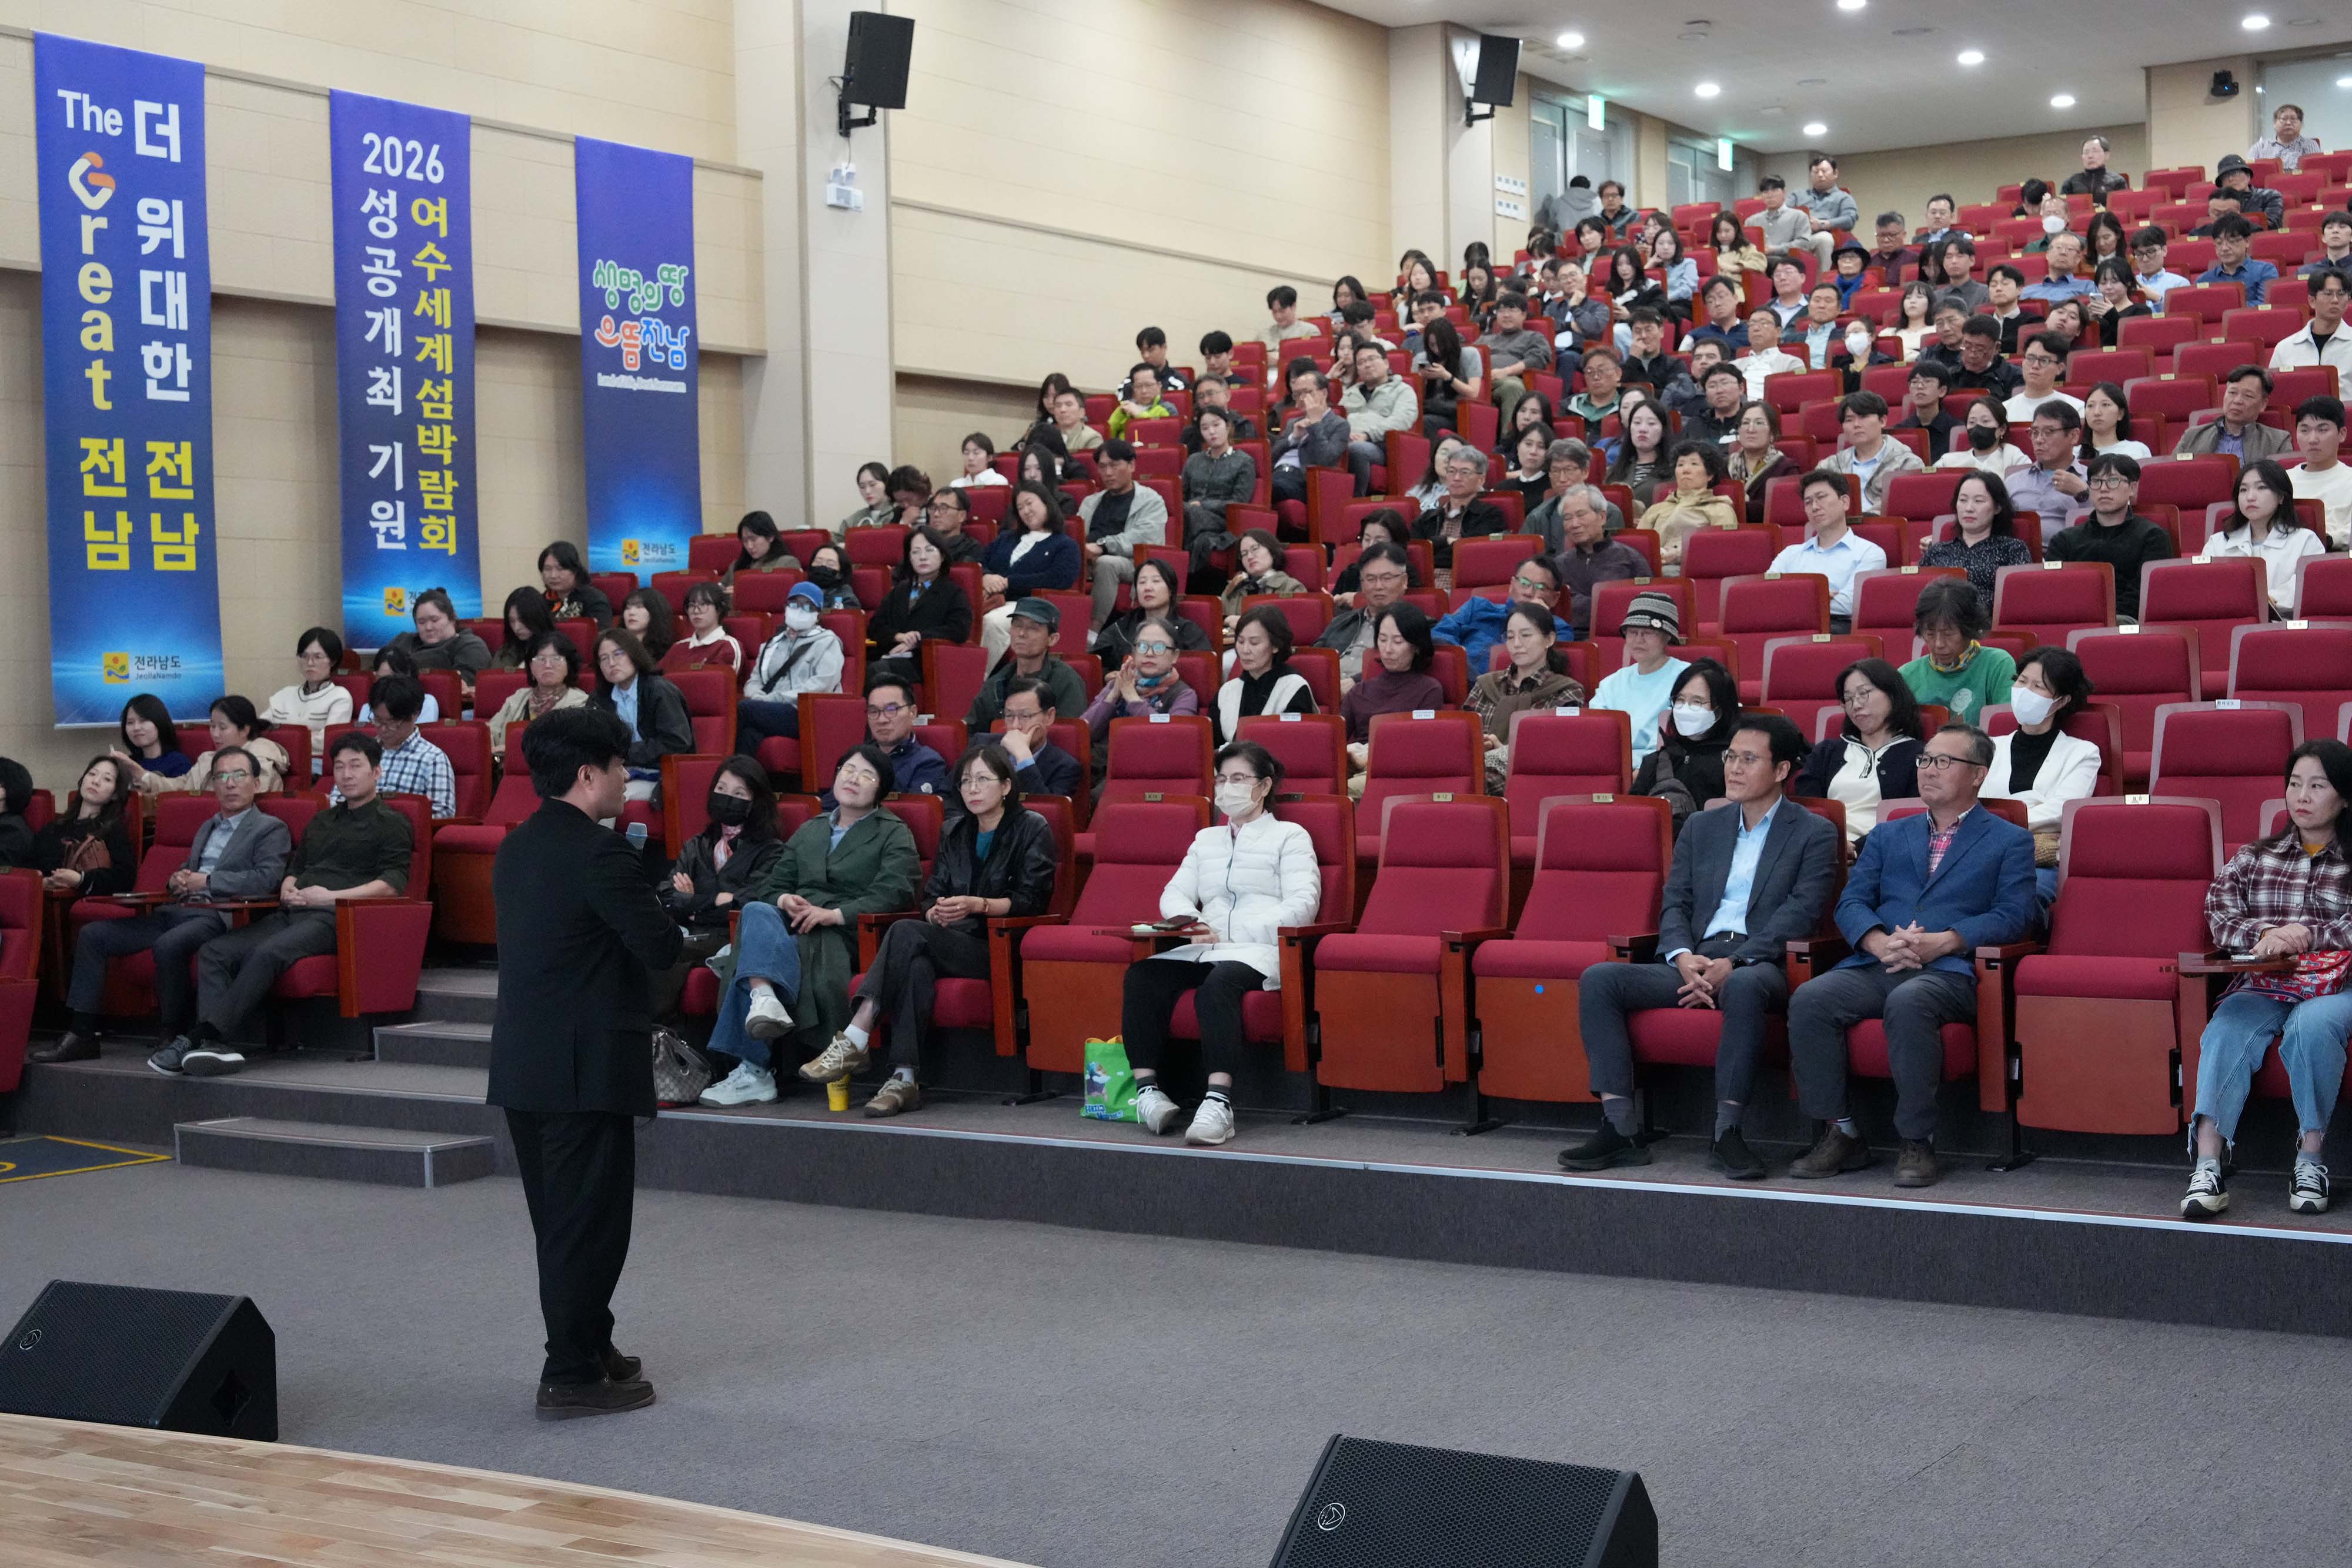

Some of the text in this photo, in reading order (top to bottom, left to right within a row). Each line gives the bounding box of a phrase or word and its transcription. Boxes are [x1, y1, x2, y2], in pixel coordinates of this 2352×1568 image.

[362, 132, 445, 184] 2026
[593, 259, 663, 315] 생명의
[57, 89, 133, 570] The Great 전남
[133, 99, 199, 571] 더 위대한 전남
[594, 315, 690, 371] 으뜸 전남
[360, 188, 407, 550] 성공개최 기원
[643, 543, 676, 556] 전라남도
[135, 655, 181, 670] 전라남도
